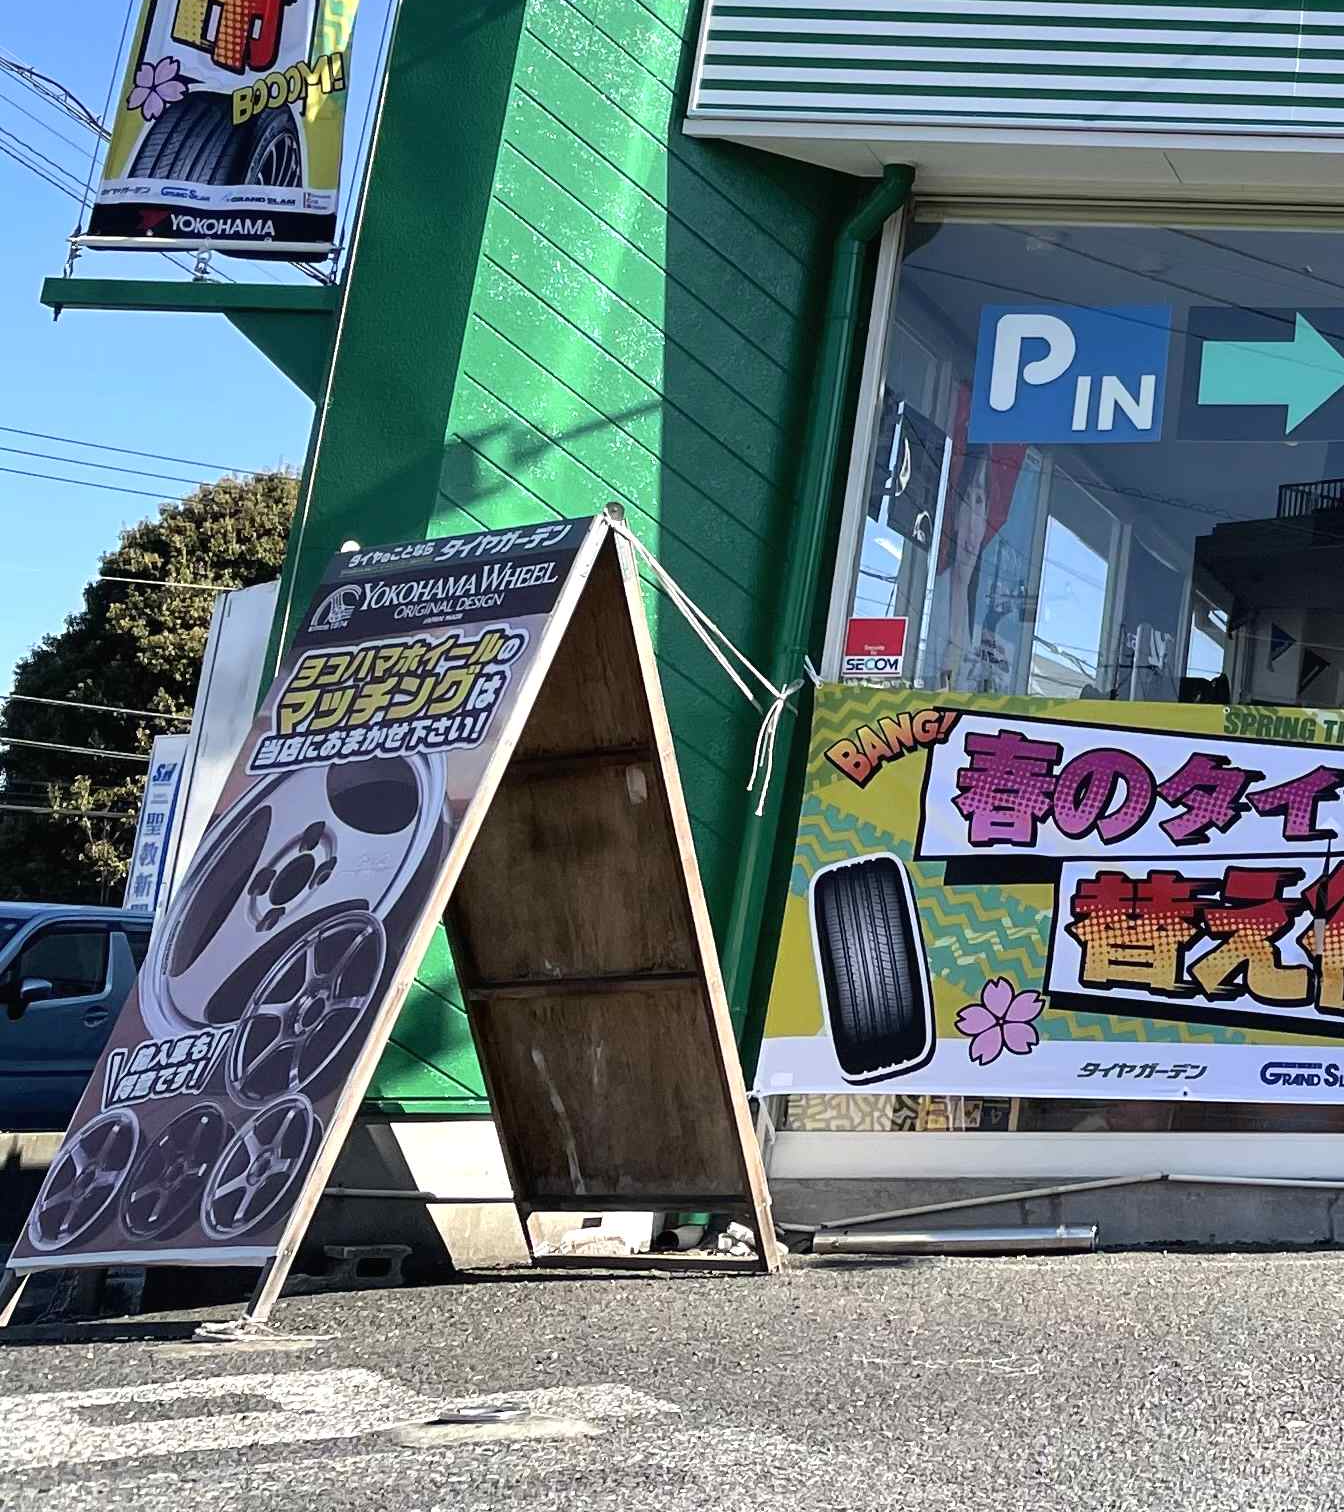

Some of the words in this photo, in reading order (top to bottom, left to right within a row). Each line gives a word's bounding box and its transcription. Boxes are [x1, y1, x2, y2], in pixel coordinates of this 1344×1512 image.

[231, 52, 346, 126] BOOOM!
[170, 213, 276, 236] YOKOHAMA
[434, 523, 573, 562] タイヤガーデン
[359, 571, 480, 611] YOKOHAMA
[480, 561, 559, 593] WHEEL
[393, 599, 454, 620] ORIGINAL
[455, 592, 506, 612] DESIGN
[290, 631, 523, 689] ヨコハマホイールの
[845, 657, 900, 672] SECOM
[279, 664, 503, 736] マッチングは
[254, 712, 487, 767] 当店におまかせ下さい！
[1222, 709, 1318, 744] SPRING
[824, 709, 960, 788] BANG!
[1076, 1061, 1209, 1080] タイヤガーデン
[1260, 1061, 1323, 1087] GRAND
